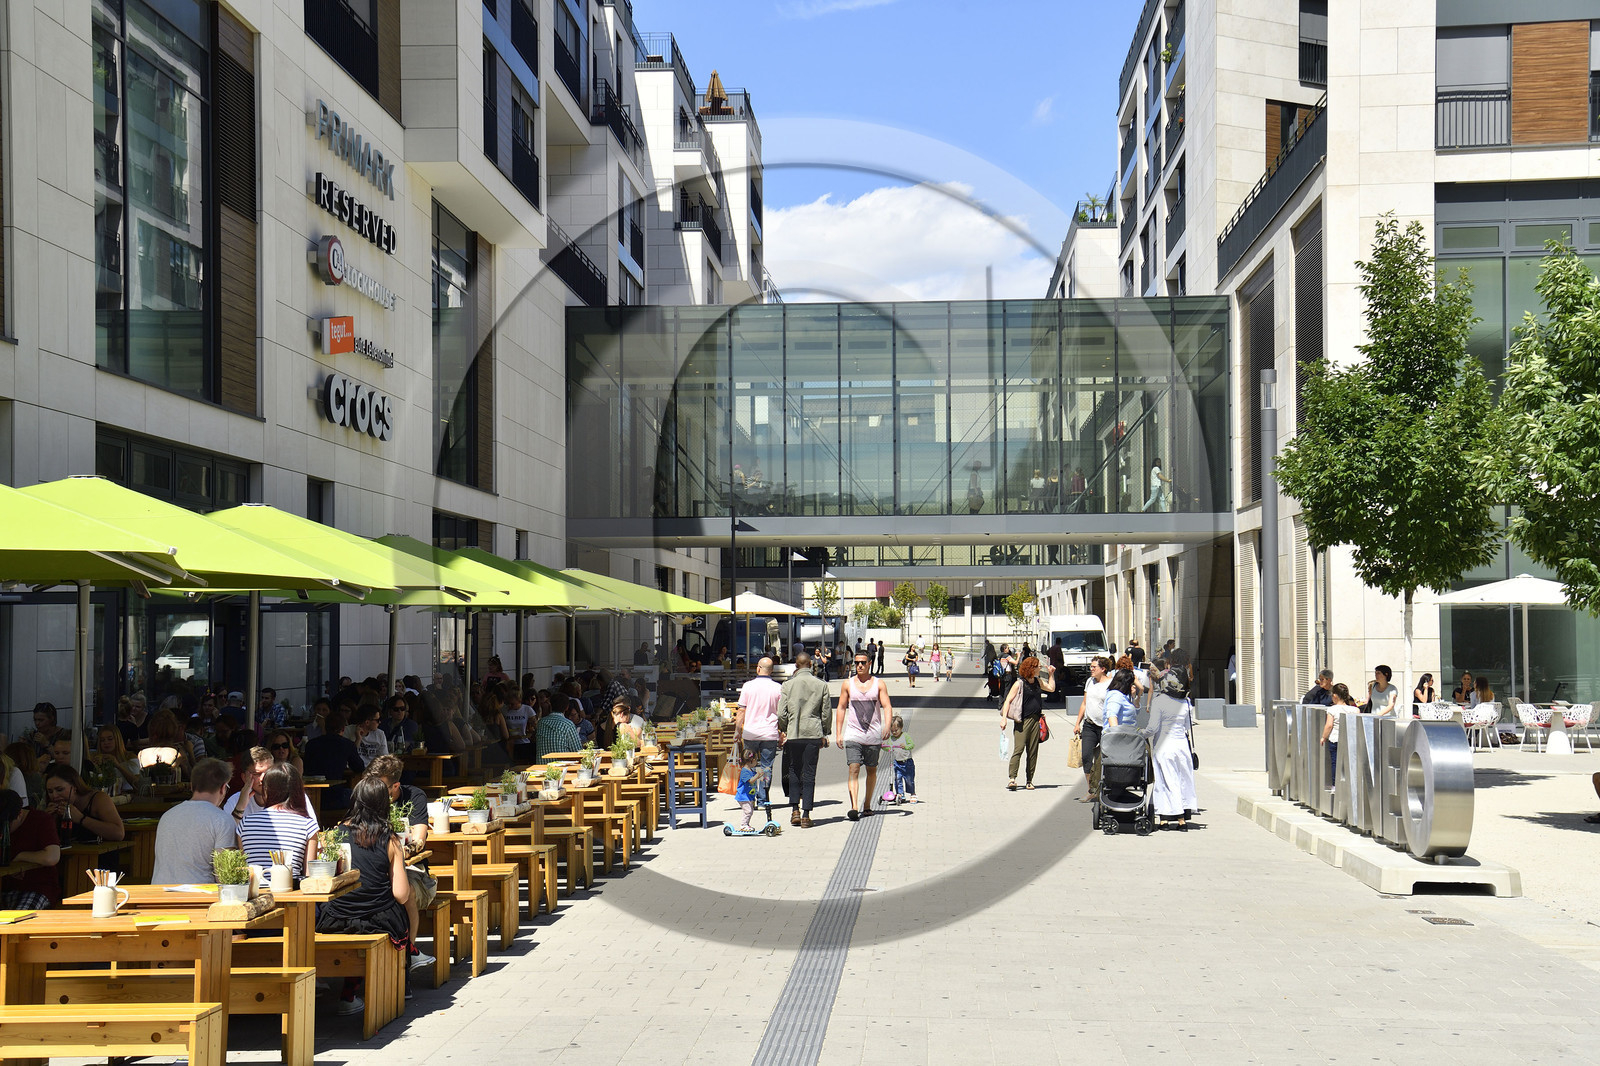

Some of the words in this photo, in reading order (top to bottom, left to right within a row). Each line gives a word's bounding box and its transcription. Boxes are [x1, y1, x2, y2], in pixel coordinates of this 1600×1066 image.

[315, 98, 394, 201] PRIMARK
[316, 172, 397, 255] RESERVED
[324, 373, 393, 442] crocs
[696, 619, 703, 628] P
